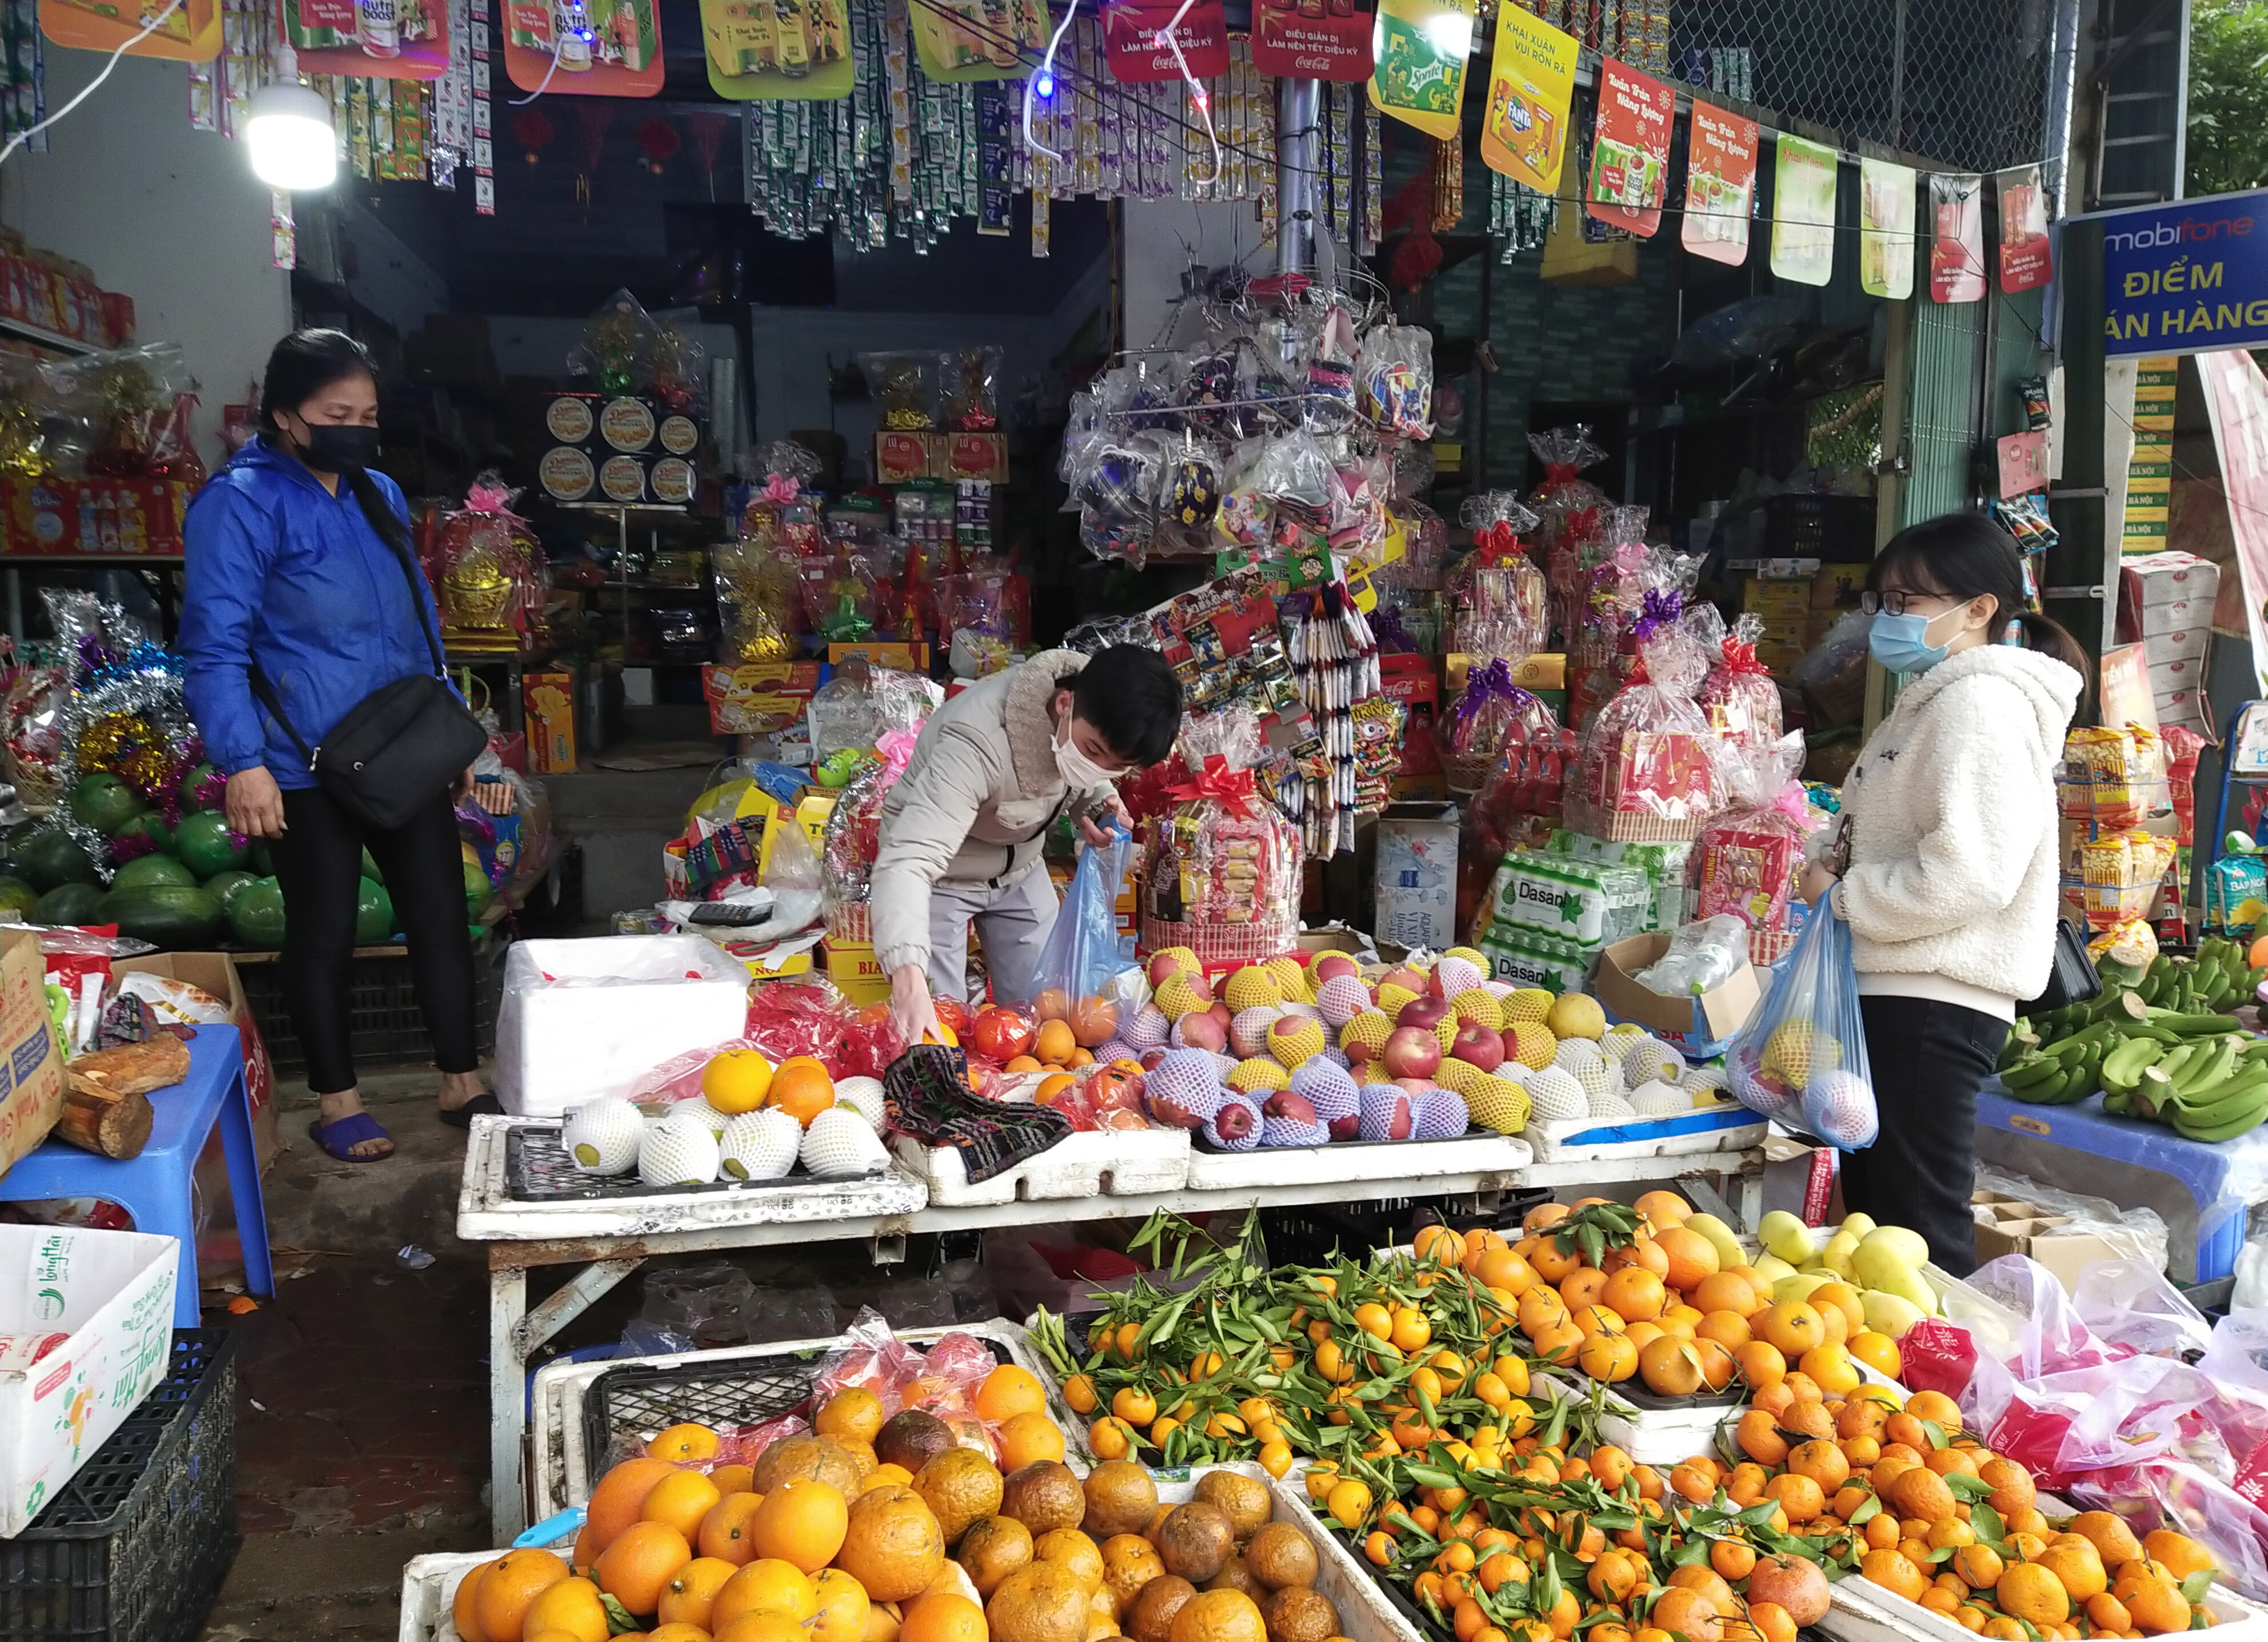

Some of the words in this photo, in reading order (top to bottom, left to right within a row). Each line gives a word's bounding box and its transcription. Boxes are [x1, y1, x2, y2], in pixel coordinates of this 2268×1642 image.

[362, 9, 396, 21] boost
[1122, 42, 1141, 53] LÀM
[1179, 38, 1200, 50] DIỆU
[1201, 36, 1212, 47] KỲ
[1183, 27, 1192, 38] DỊ
[1285, 28, 1305, 39] ĐIỀU
[1307, 30, 1328, 42] GIẢN
[1330, 35, 1339, 45] DỊ
[1506, 19, 1529, 41] KHAI
[1530, 33, 1556, 55] XUÂN
[1267, 38, 1285, 49] LÀM
[1287, 41, 1305, 51] NÊN
[1307, 42, 1324, 53] TẾT
[1324, 46, 1345, 56] DIỆU
[1347, 46, 1359, 56] KỲ
[1514, 39, 1530, 57] VUI
[1532, 49, 1551, 70] RỘN
[1554, 61, 1566, 76] RÃ
[1411, 64, 1440, 86] Sprite
[1608, 73, 1631, 93] Xuân
[1631, 83, 1651, 103] Tràn
[1507, 99, 1532, 129] FANTA
[1640, 103, 1665, 126] Lượng
[1696, 114, 1718, 133] Xuân
[2104, 216, 2254, 252] mobifone
[2123, 255, 2224, 298] ĐIỂM
[2105, 309, 2150, 340] ÁN
[2161, 299, 2268, 336] HÀNG
[1519, 881, 1567, 908] Dasani
[858, 961, 883, 975] BIA
[1499, 958, 1547, 985] Dasani
